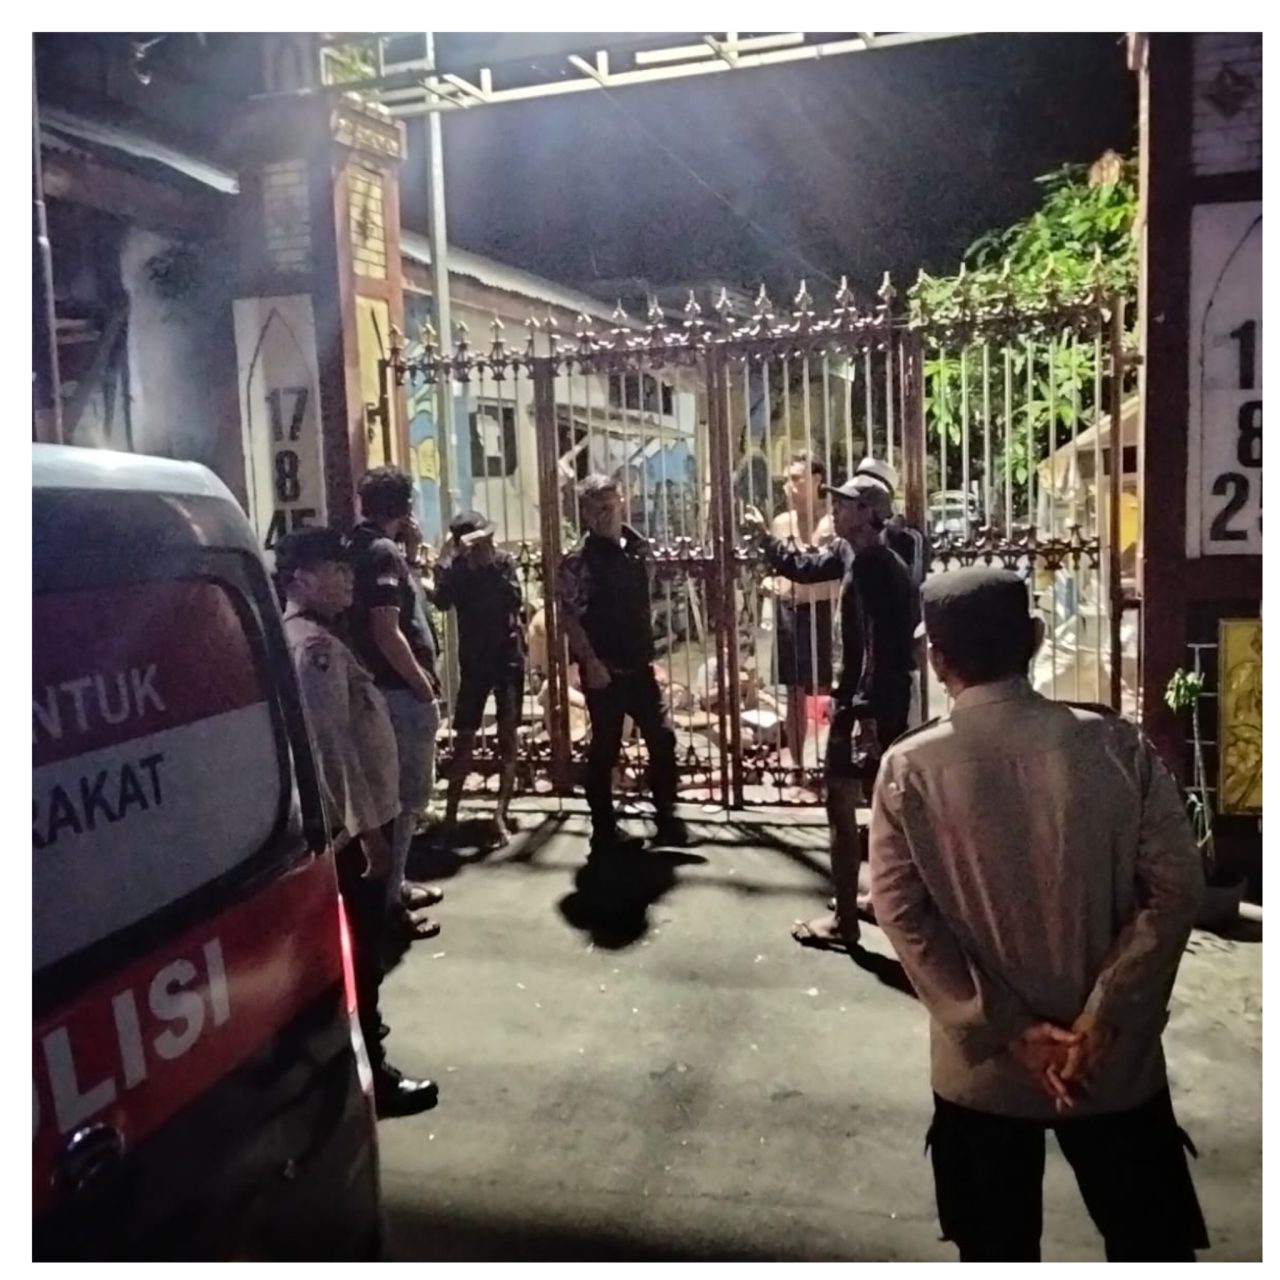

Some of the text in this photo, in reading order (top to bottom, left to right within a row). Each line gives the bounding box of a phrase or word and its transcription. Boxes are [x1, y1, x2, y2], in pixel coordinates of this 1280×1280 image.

[266, 388, 309, 442] 17
[274, 449, 300, 503] 8
[1209, 471, 1262, 541] 2
[31, 936, 232, 1140] LISI
